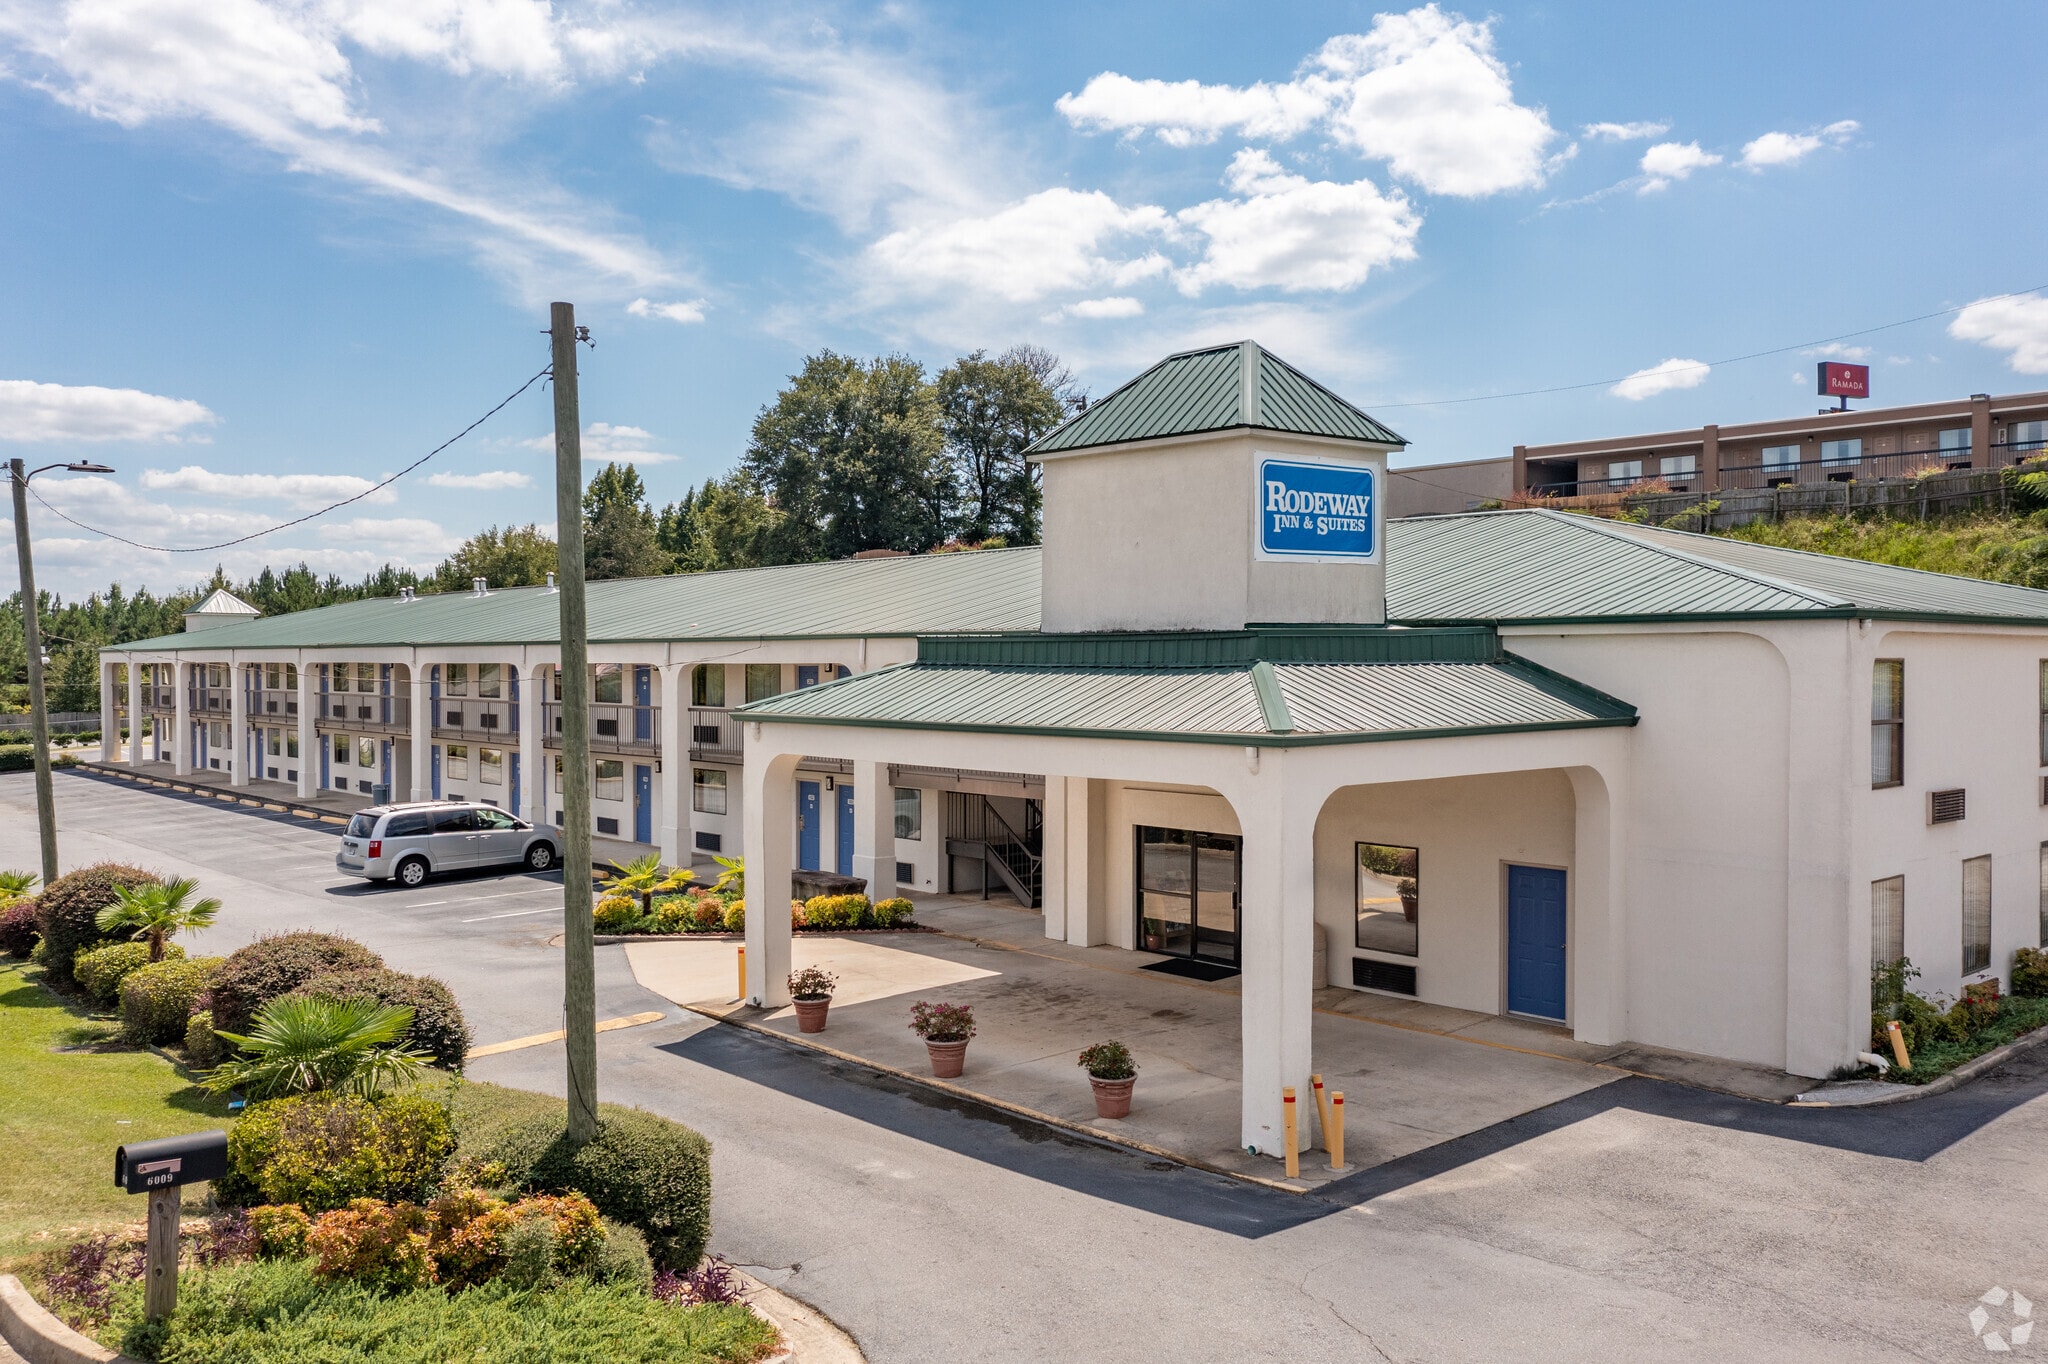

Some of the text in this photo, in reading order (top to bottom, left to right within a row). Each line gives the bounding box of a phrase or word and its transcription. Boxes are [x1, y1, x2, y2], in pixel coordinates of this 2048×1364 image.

[1832, 377, 1864, 390] RAMADA
[1266, 480, 1370, 517] RODEWAY
[1273, 514, 1365, 535] INN & SUITES
[147, 1173, 173, 1186] 6009
